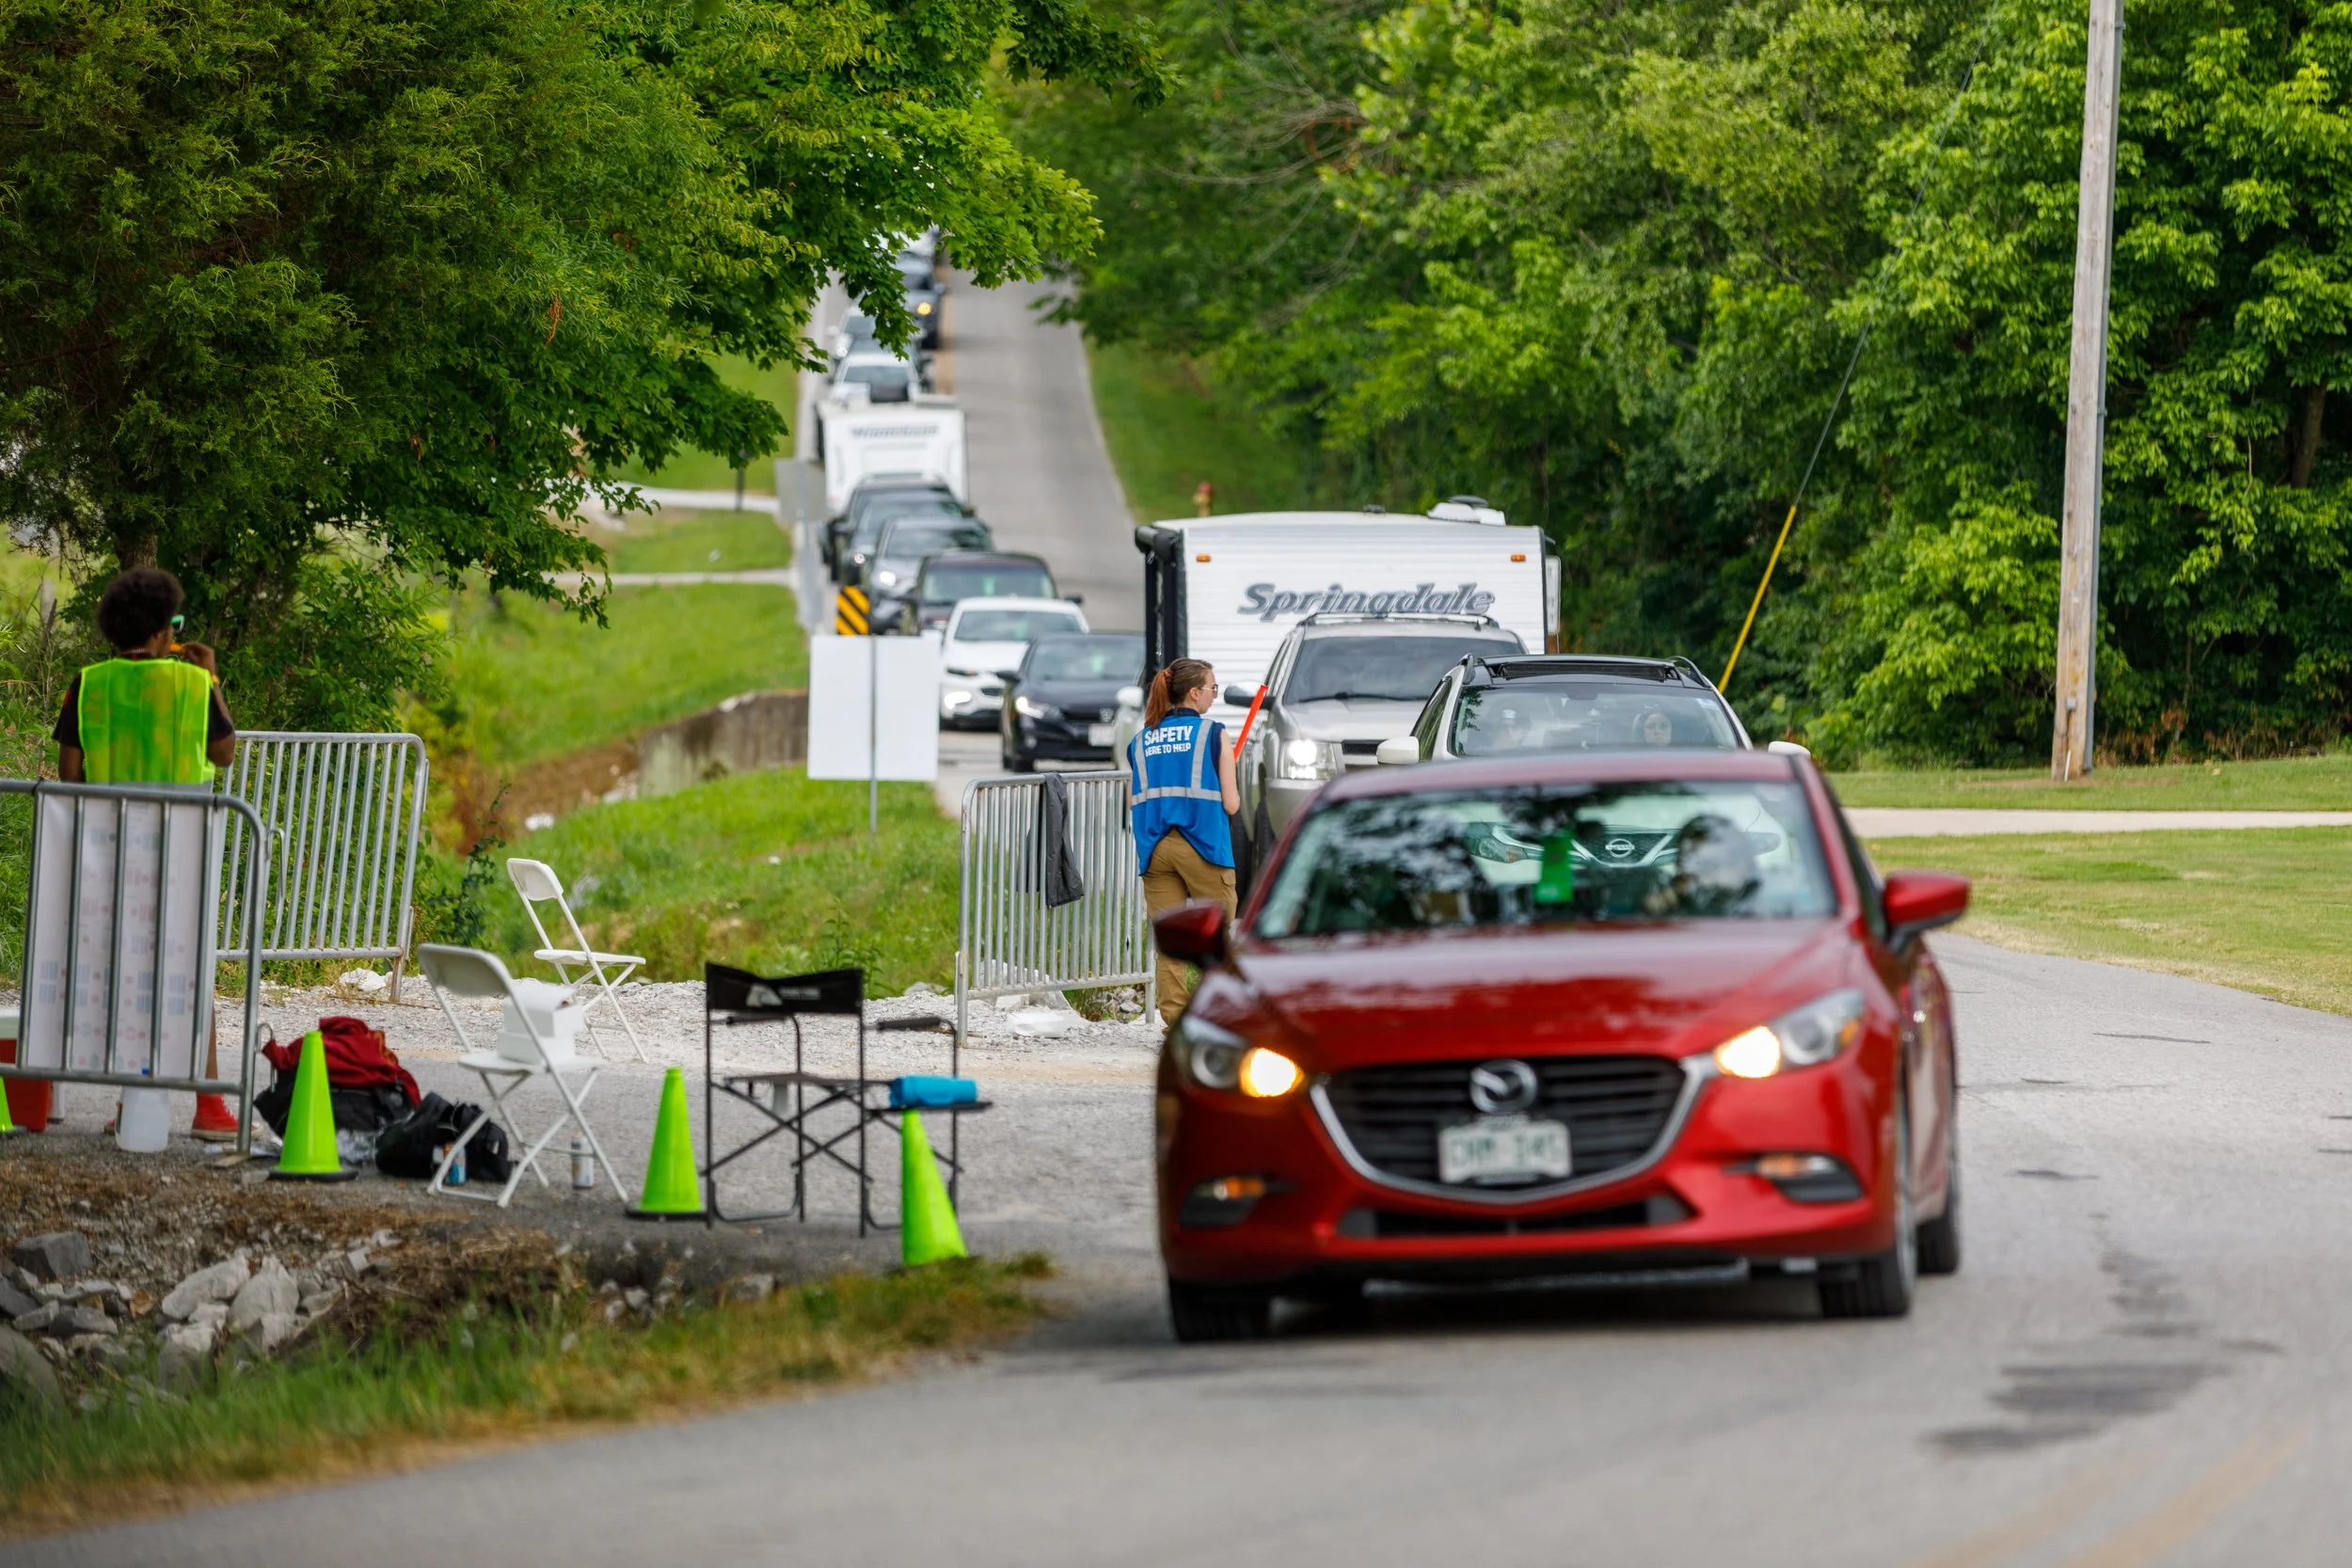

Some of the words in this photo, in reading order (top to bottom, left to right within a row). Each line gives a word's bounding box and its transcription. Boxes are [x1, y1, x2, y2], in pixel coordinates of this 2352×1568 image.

[1237, 582, 1495, 622] Springdale
[1144, 725, 1193, 746] SAFETY
[1163, 744, 1171, 753] TO
[1172, 742, 1191, 752] HELP
